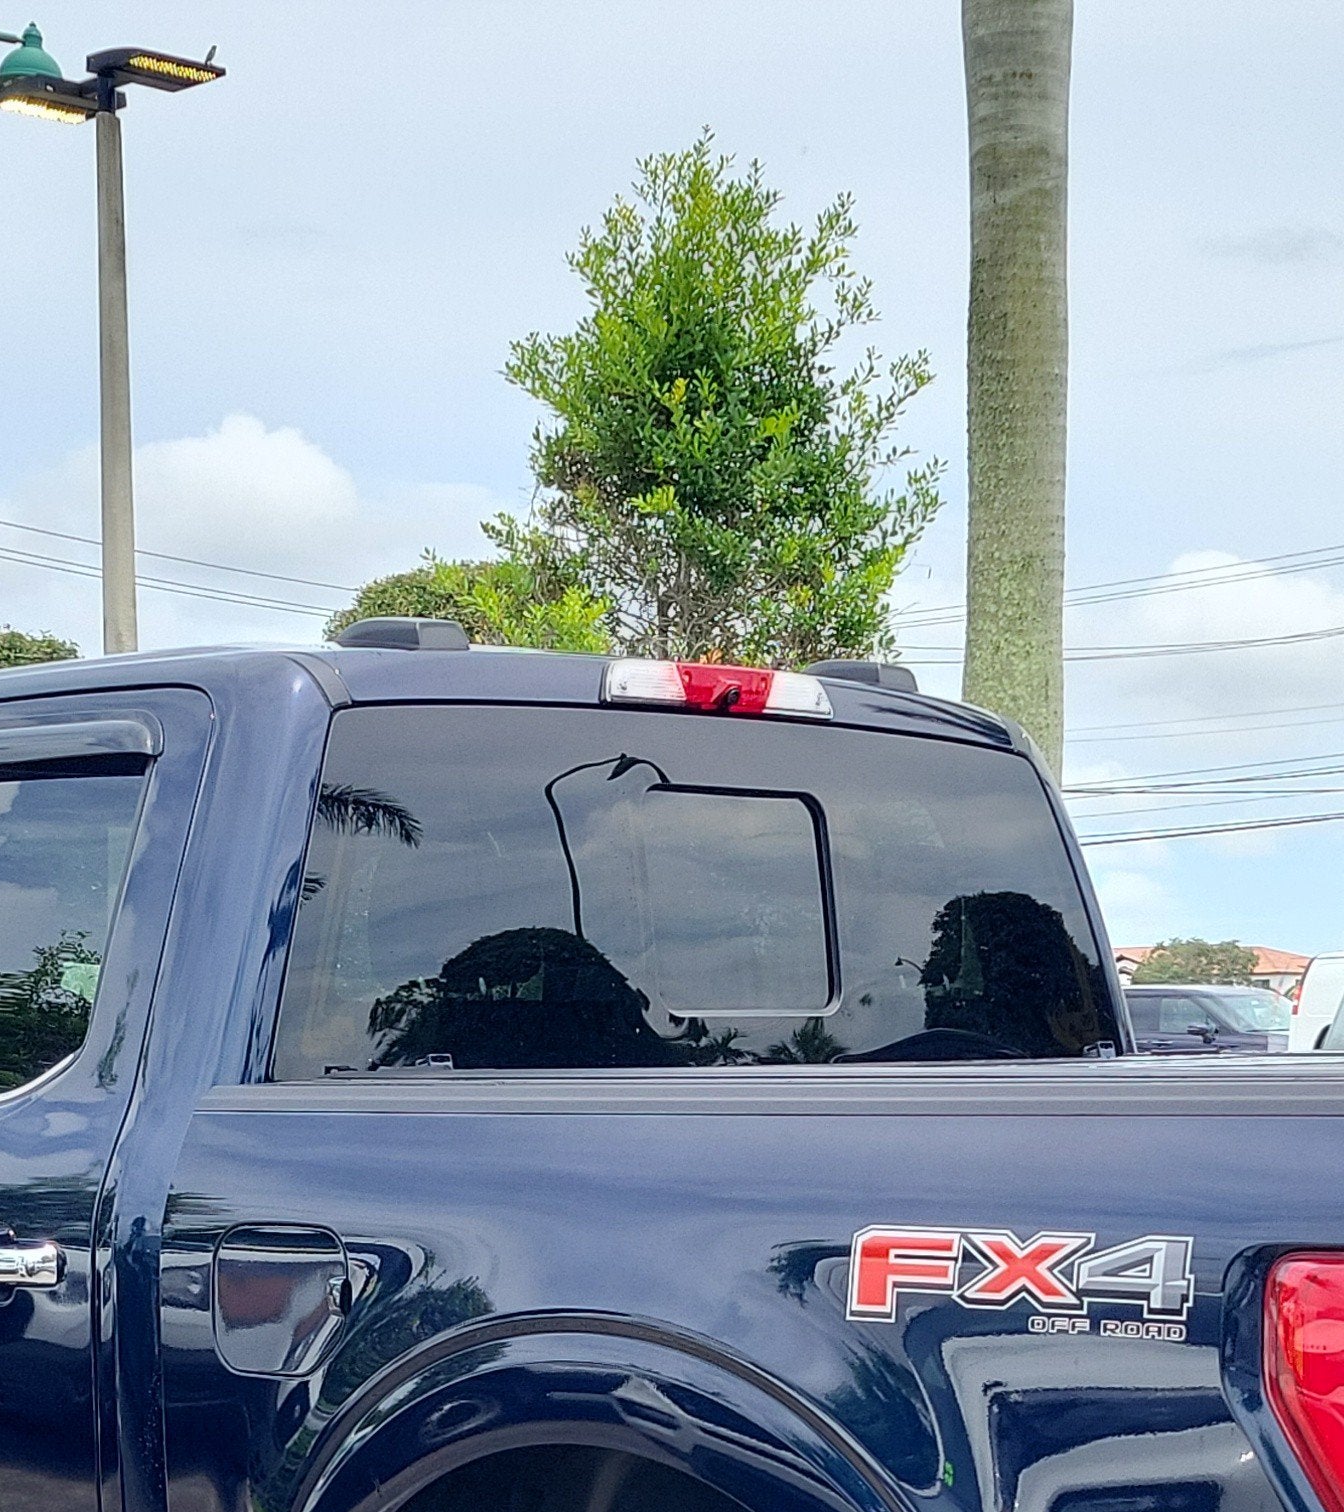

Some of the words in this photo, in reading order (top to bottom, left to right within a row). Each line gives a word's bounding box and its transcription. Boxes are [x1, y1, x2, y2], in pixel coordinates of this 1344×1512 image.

[845, 1224, 1196, 1324] FX4
[1027, 1315, 1091, 1334] OFF
[1099, 1320, 1188, 1342] ROAD
